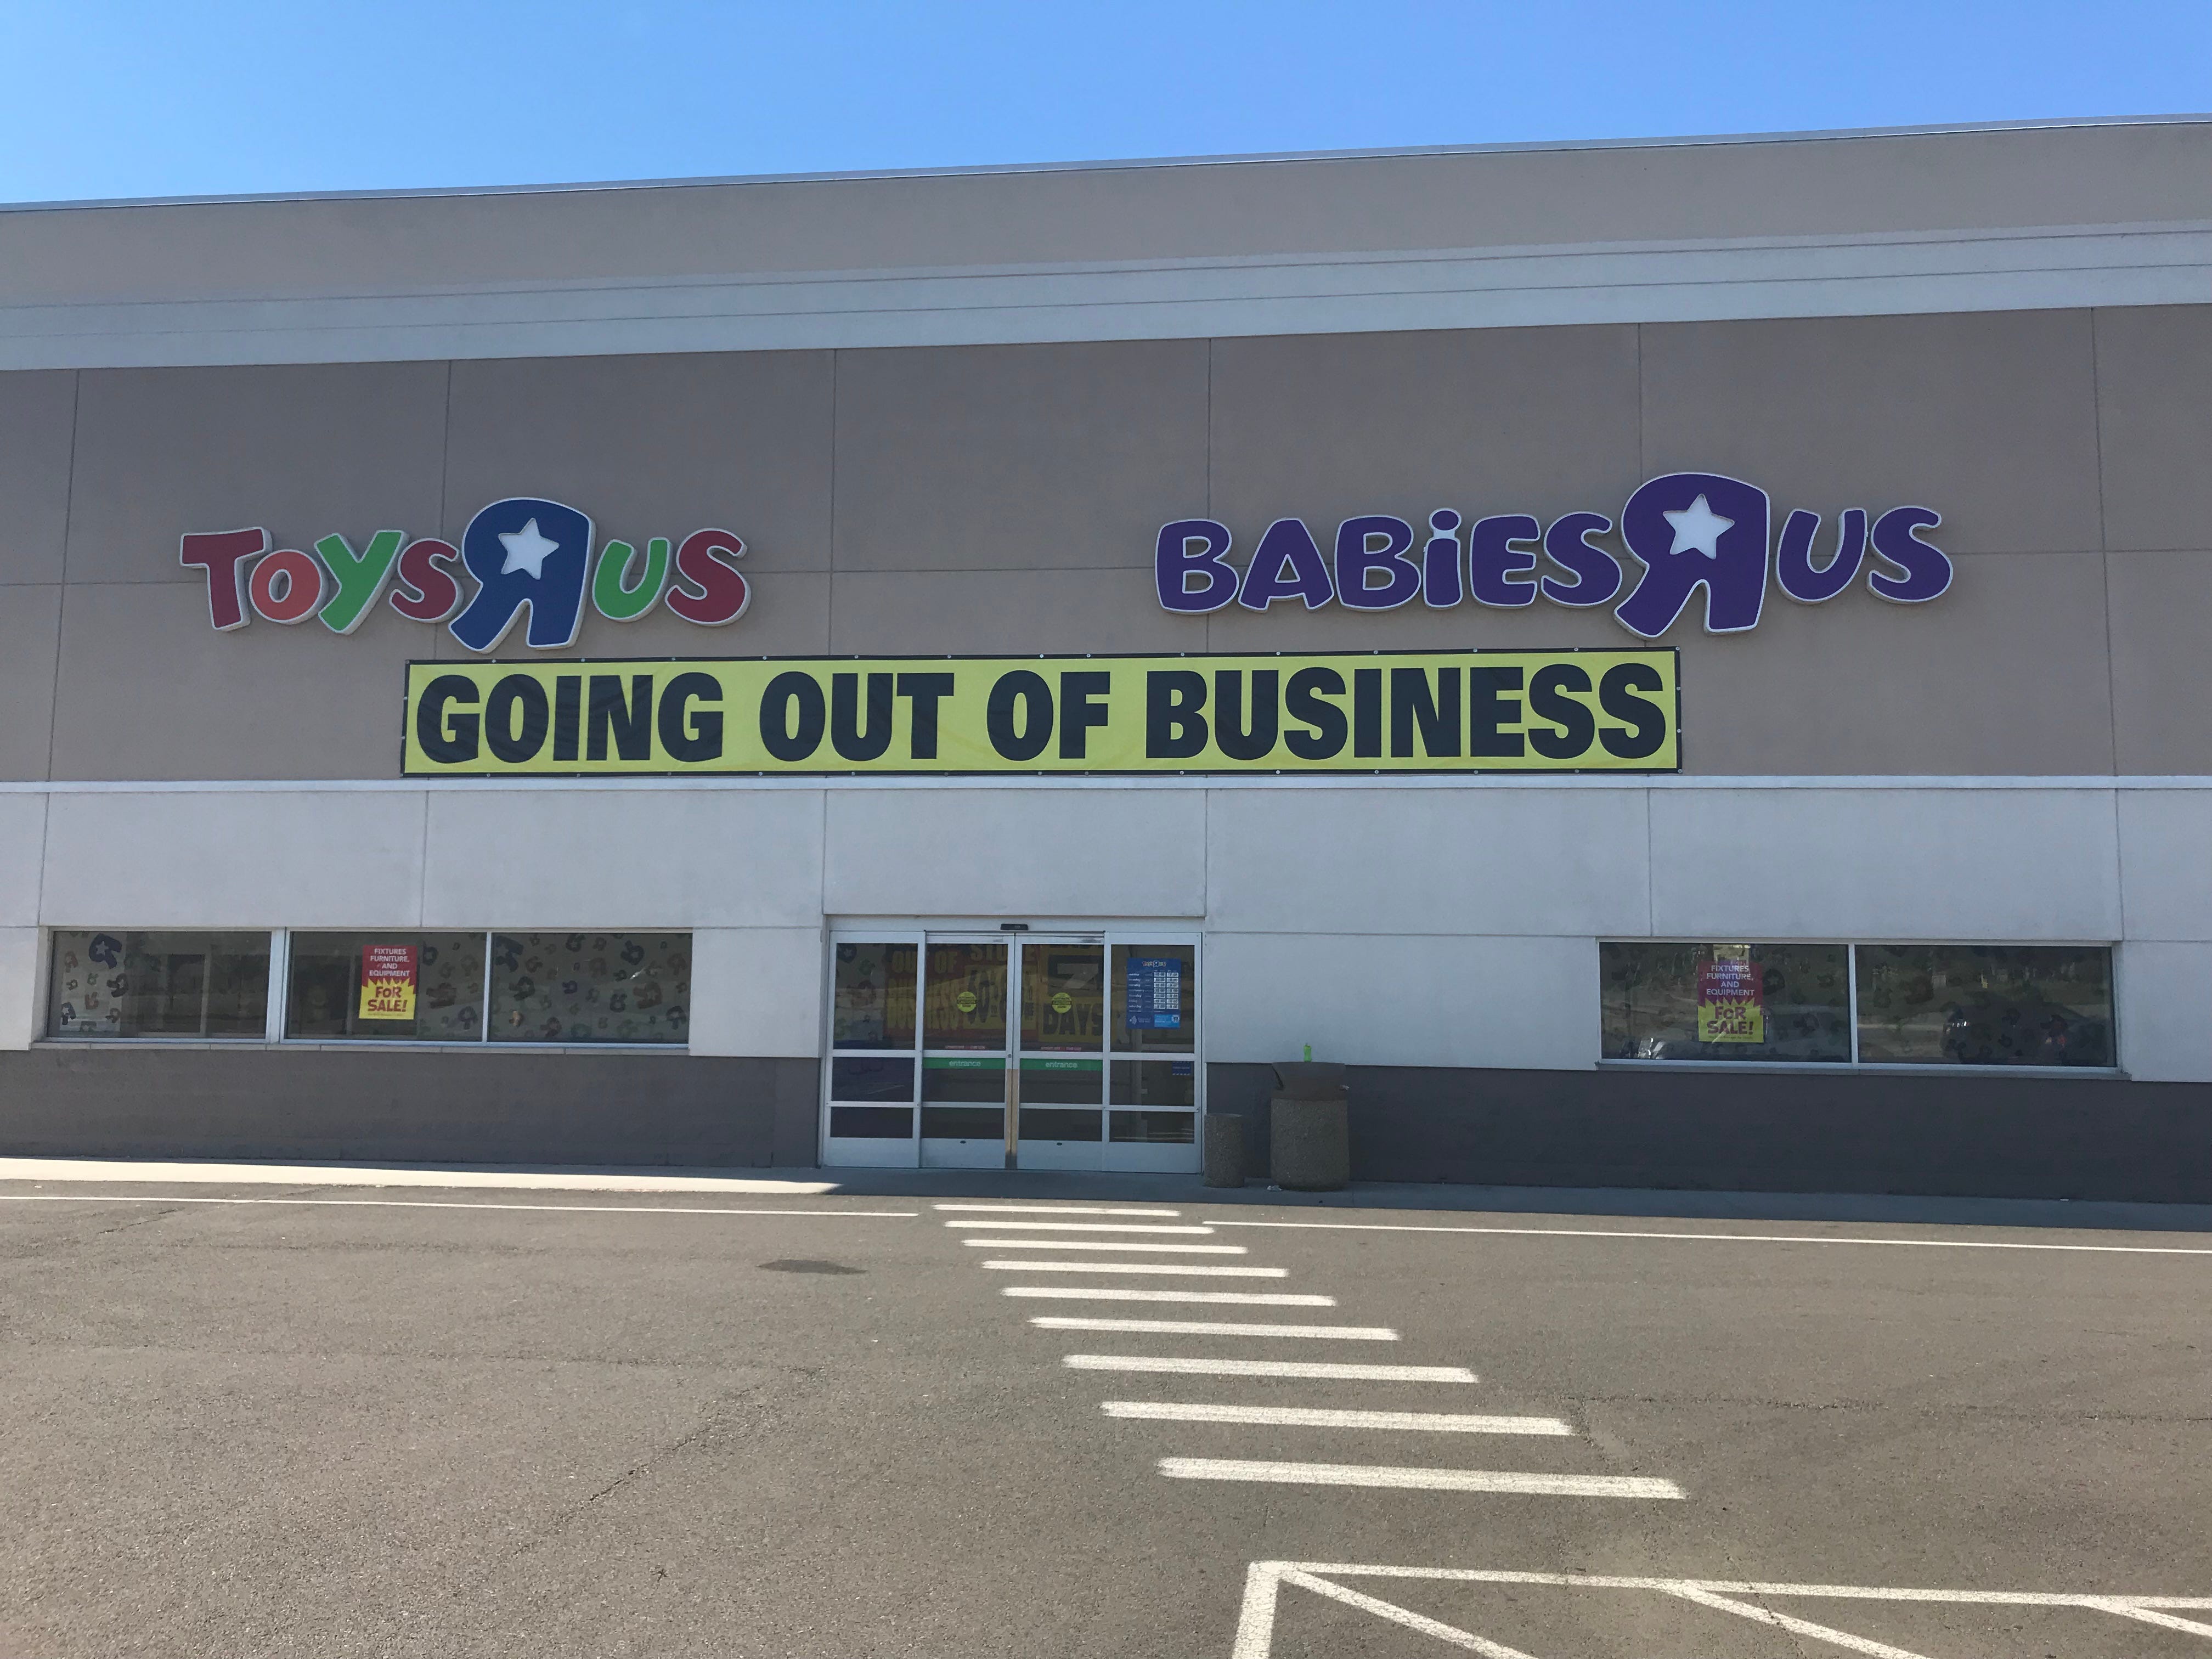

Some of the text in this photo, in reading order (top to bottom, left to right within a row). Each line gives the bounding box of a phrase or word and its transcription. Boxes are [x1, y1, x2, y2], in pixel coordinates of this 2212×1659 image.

[1776, 505, 1953, 605] US
[416, 663, 1666, 764] GOING OUT OF BUSINESS
[375, 986, 402, 998] FOR
[1706, 988, 1754, 996] EQUIPMENT
[368, 999, 408, 1012] SALE!
[1715, 1006, 1747, 1020] FOR
[1707, 1020, 1753, 1035] SALE!
